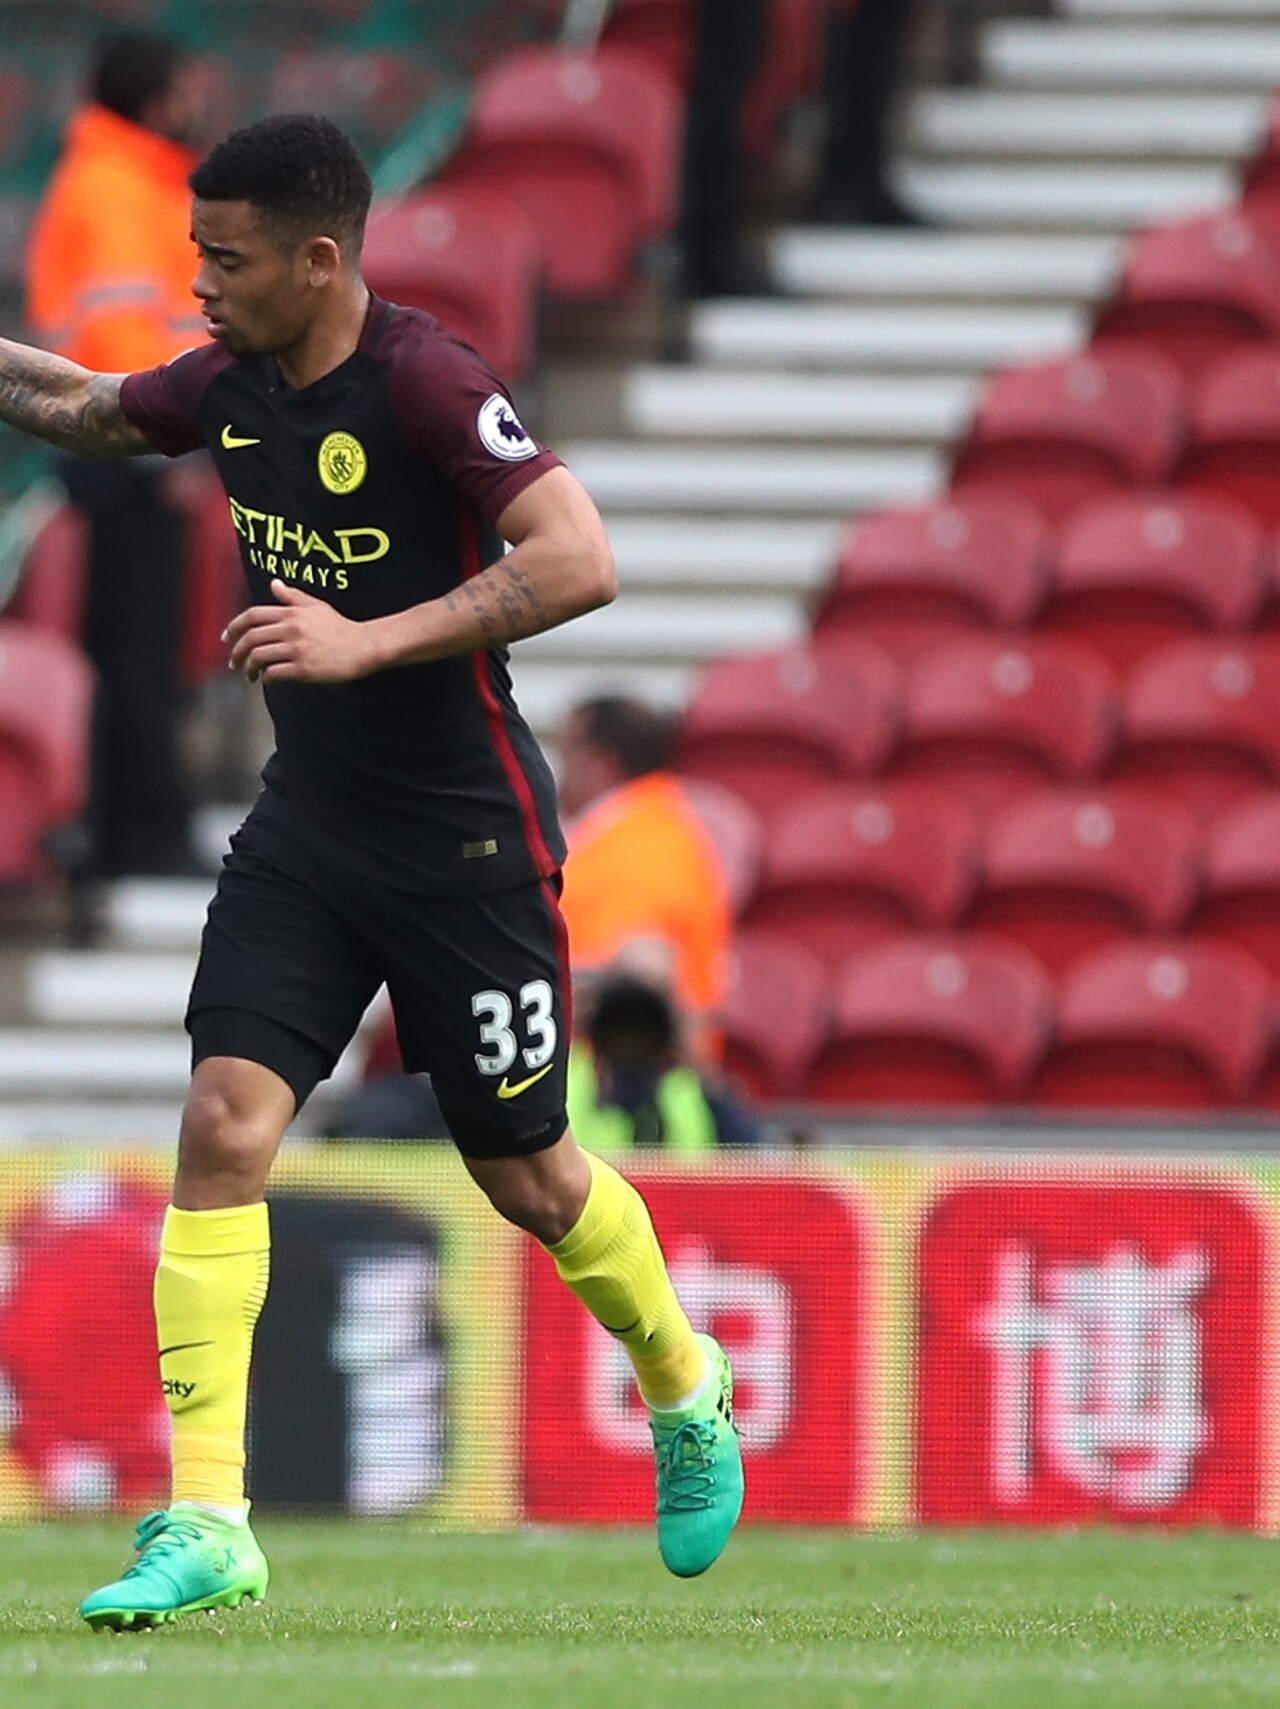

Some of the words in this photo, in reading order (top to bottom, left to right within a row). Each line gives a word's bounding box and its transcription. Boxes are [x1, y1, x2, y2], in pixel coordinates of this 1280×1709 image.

[229, 496, 390, 563] ETIHAD
[250, 548, 349, 589] AIRWAYS
[471, 979, 557, 1076] 33
